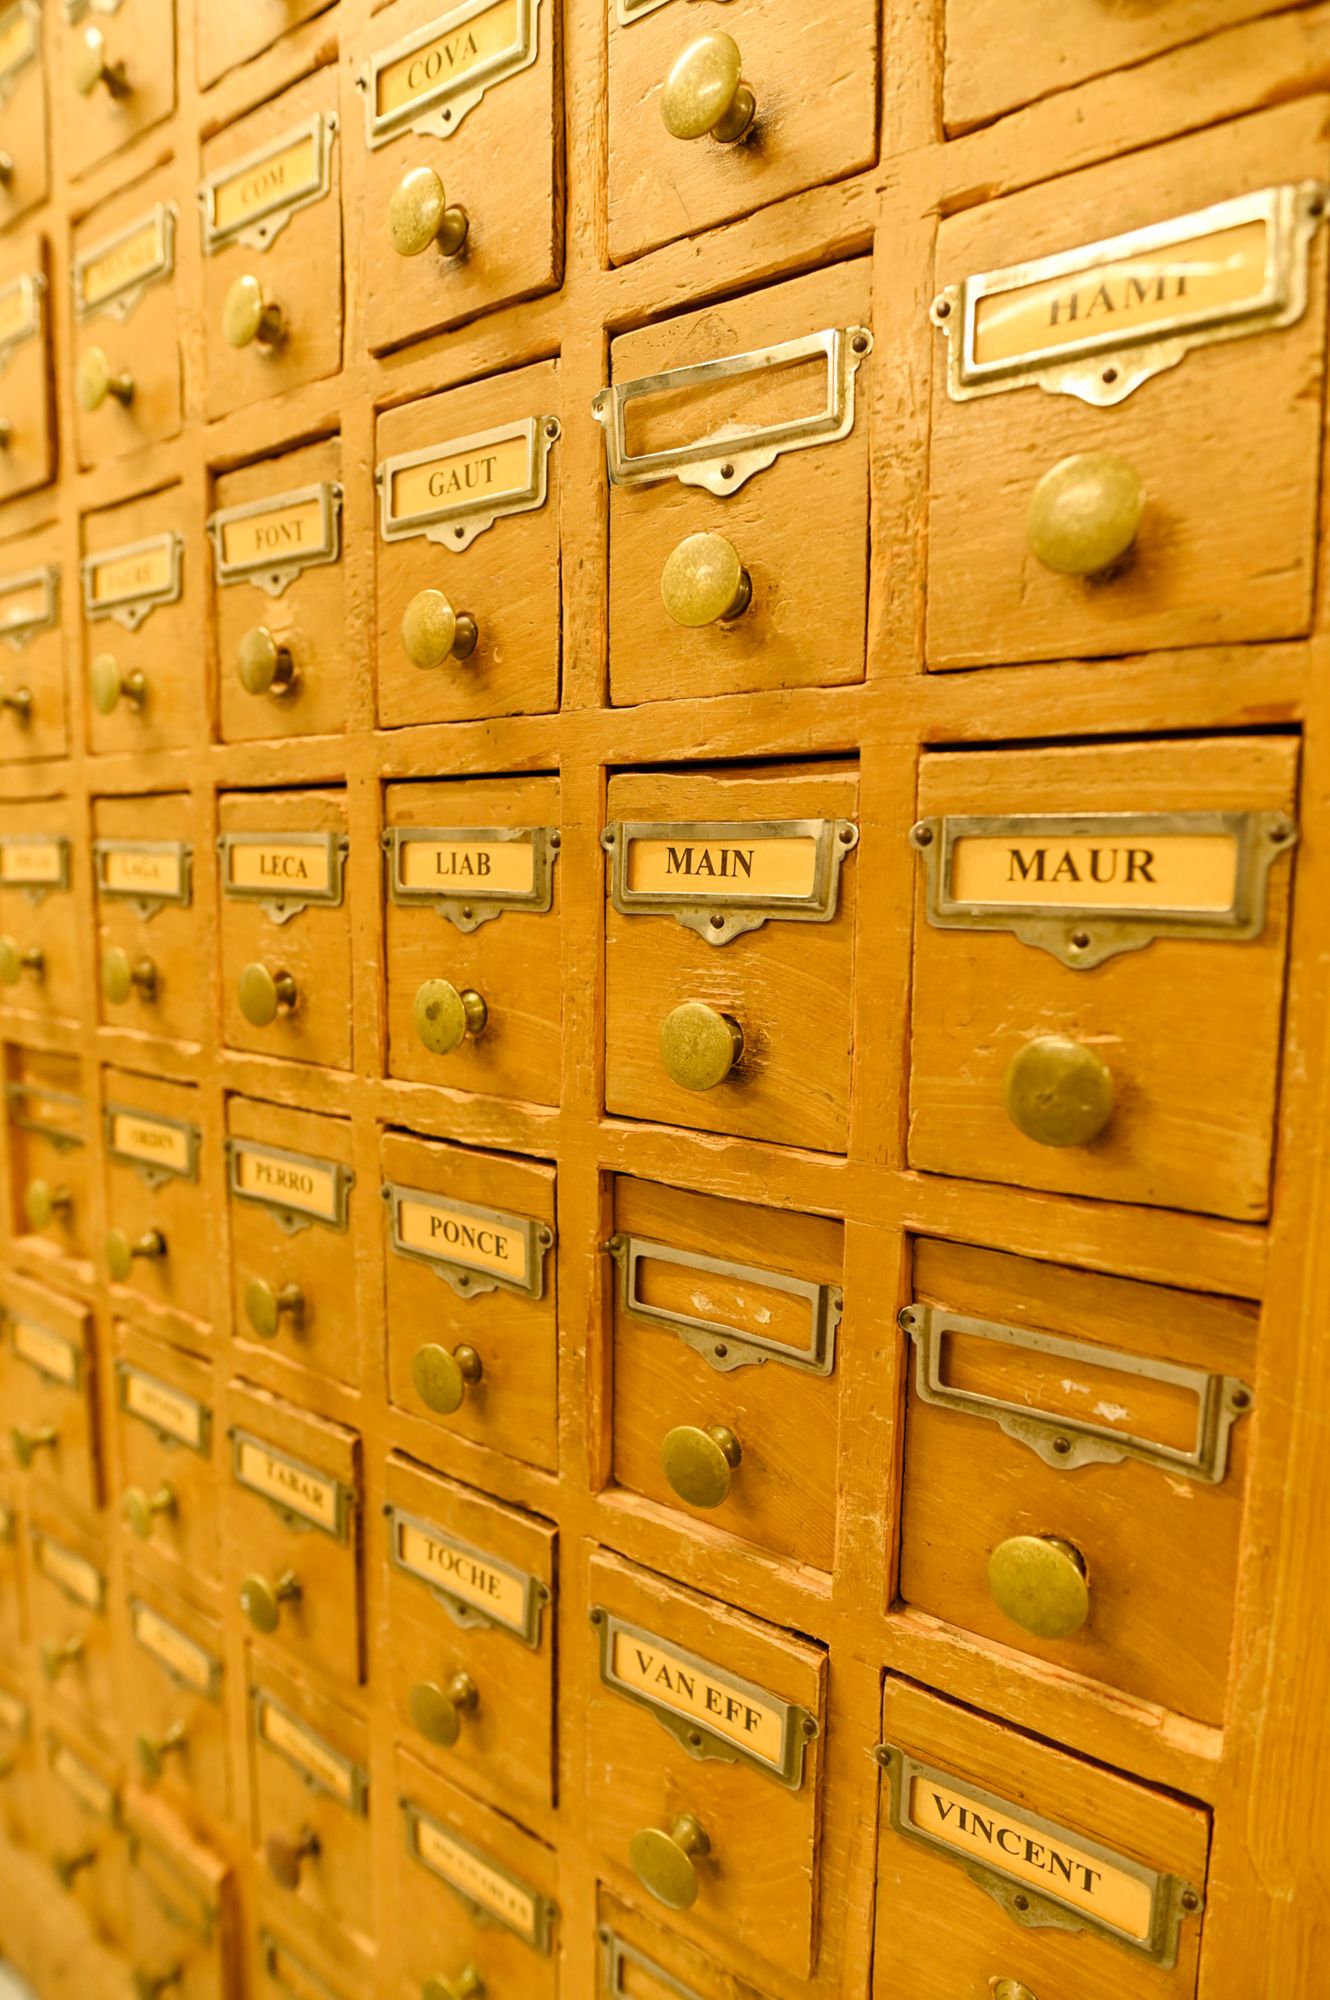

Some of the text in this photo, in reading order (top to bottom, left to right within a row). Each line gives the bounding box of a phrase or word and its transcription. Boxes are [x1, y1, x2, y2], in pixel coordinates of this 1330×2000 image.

[408, 32, 478, 89] COVA
[240, 162, 287, 208] COM
[429, 456, 497, 498] GAUT
[255, 519, 305, 550] FONT
[260, 854, 308, 879] LECA
[436, 851, 491, 877] LIAB
[665, 846, 756, 879] MAIN
[1008, 848, 1159, 883] MAUR
[255, 1161, 315, 1196] PERRO
[430, 1215, 510, 1261] PONCE
[266, 1459, 325, 1511] TABAR
[424, 1539, 502, 1601] TOCHE
[634, 1648, 763, 1734] VAN EFF
[932, 1792, 1102, 1897] VINCENT
